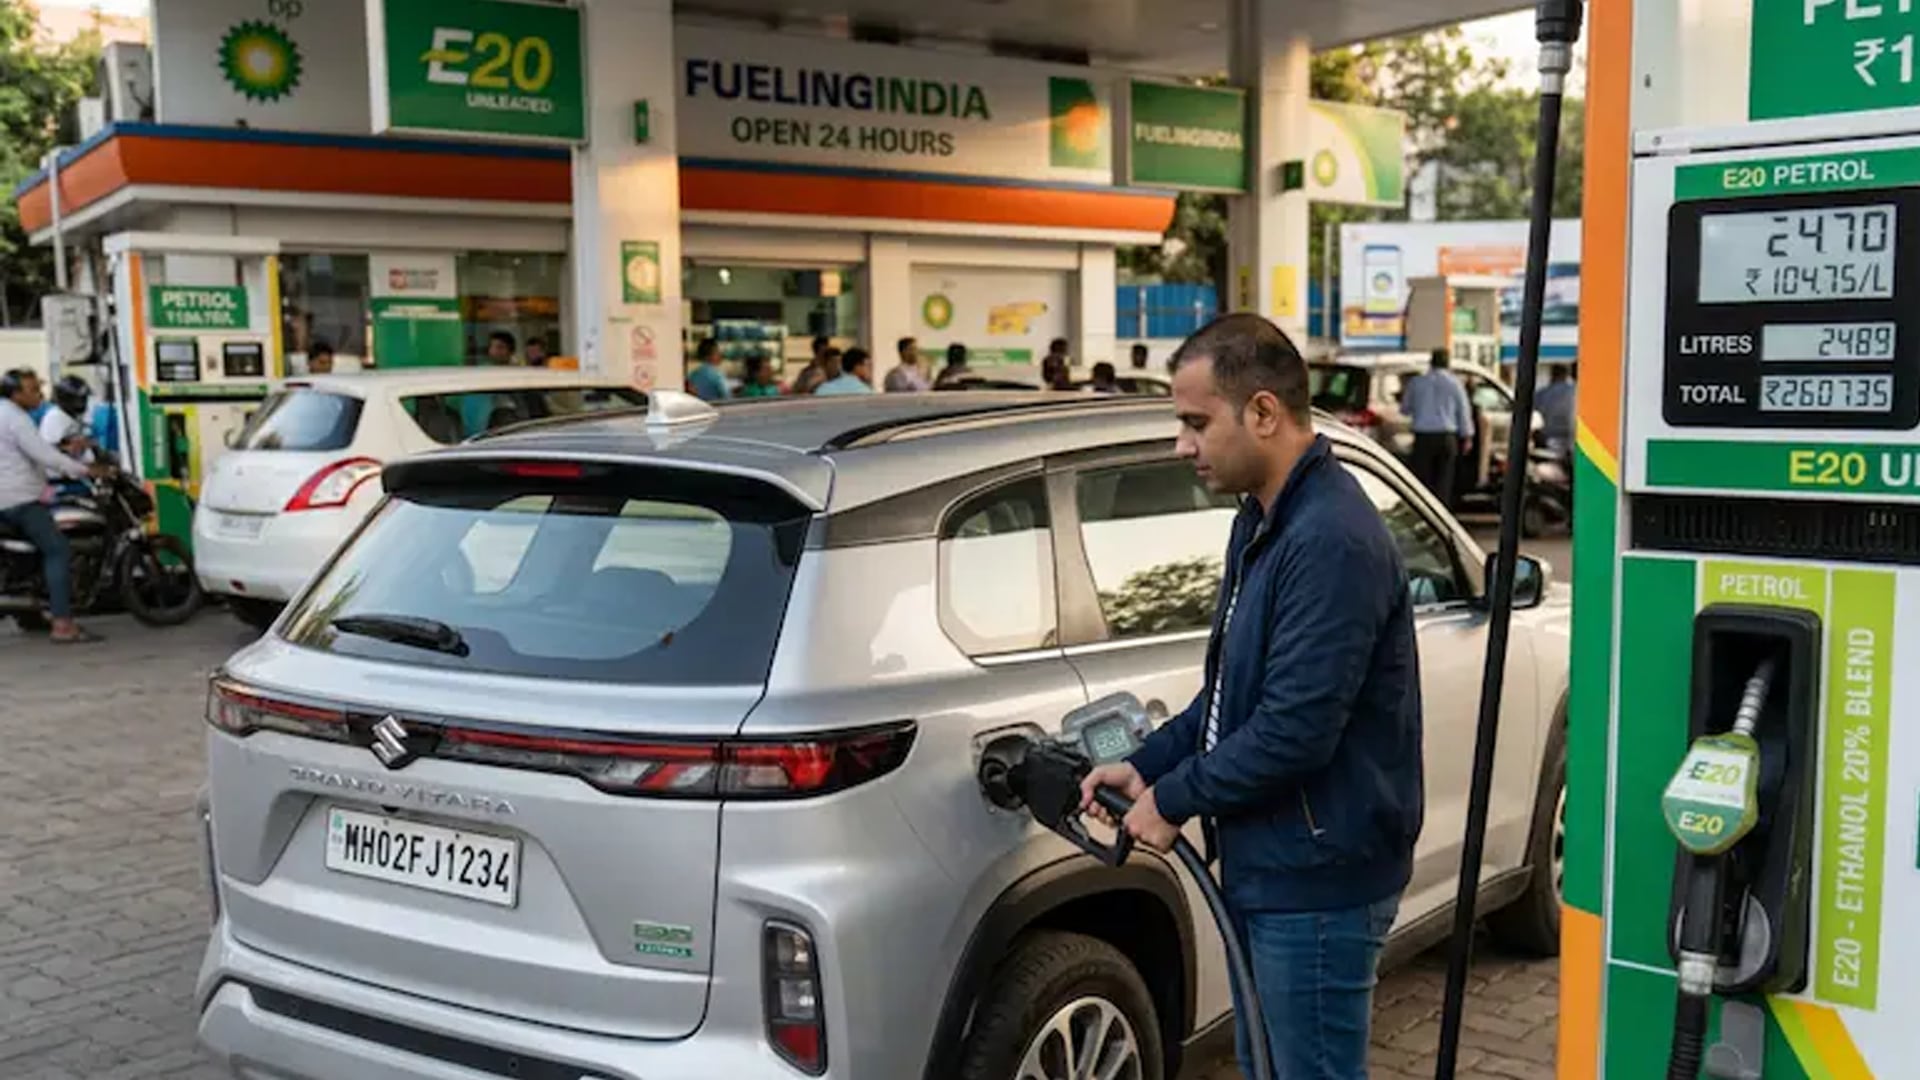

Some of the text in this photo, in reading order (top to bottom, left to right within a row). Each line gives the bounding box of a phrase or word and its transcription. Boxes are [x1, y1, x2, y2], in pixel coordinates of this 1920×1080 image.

[419, 26, 553, 92] E20
[465, 91, 554, 113] UNLEADED
[686, 59, 991, 120] FUELINGINDIA
[731, 115, 955, 157] OPEN 24 HOURS
[1723, 159, 1875, 190] E20 PETROL
[161, 291, 238, 309] PETROL
[1679, 335, 1753, 355] LITRES
[1679, 385, 1746, 404] TOTAL
[1789, 449, 1920, 487] E20 U
[1719, 572, 1809, 601] PETROL
[1844, 627, 1875, 717] BLEND
[1843, 724, 1872, 784] 20%
[1687, 760, 1742, 787] E20
[394, 783, 519, 816] VITARA
[1678, 810, 1725, 836] E20
[344, 823, 511, 893] MH02FJ1234
[1835, 788, 1870, 914] ETHANOL
[1833, 937, 1861, 988] E20
